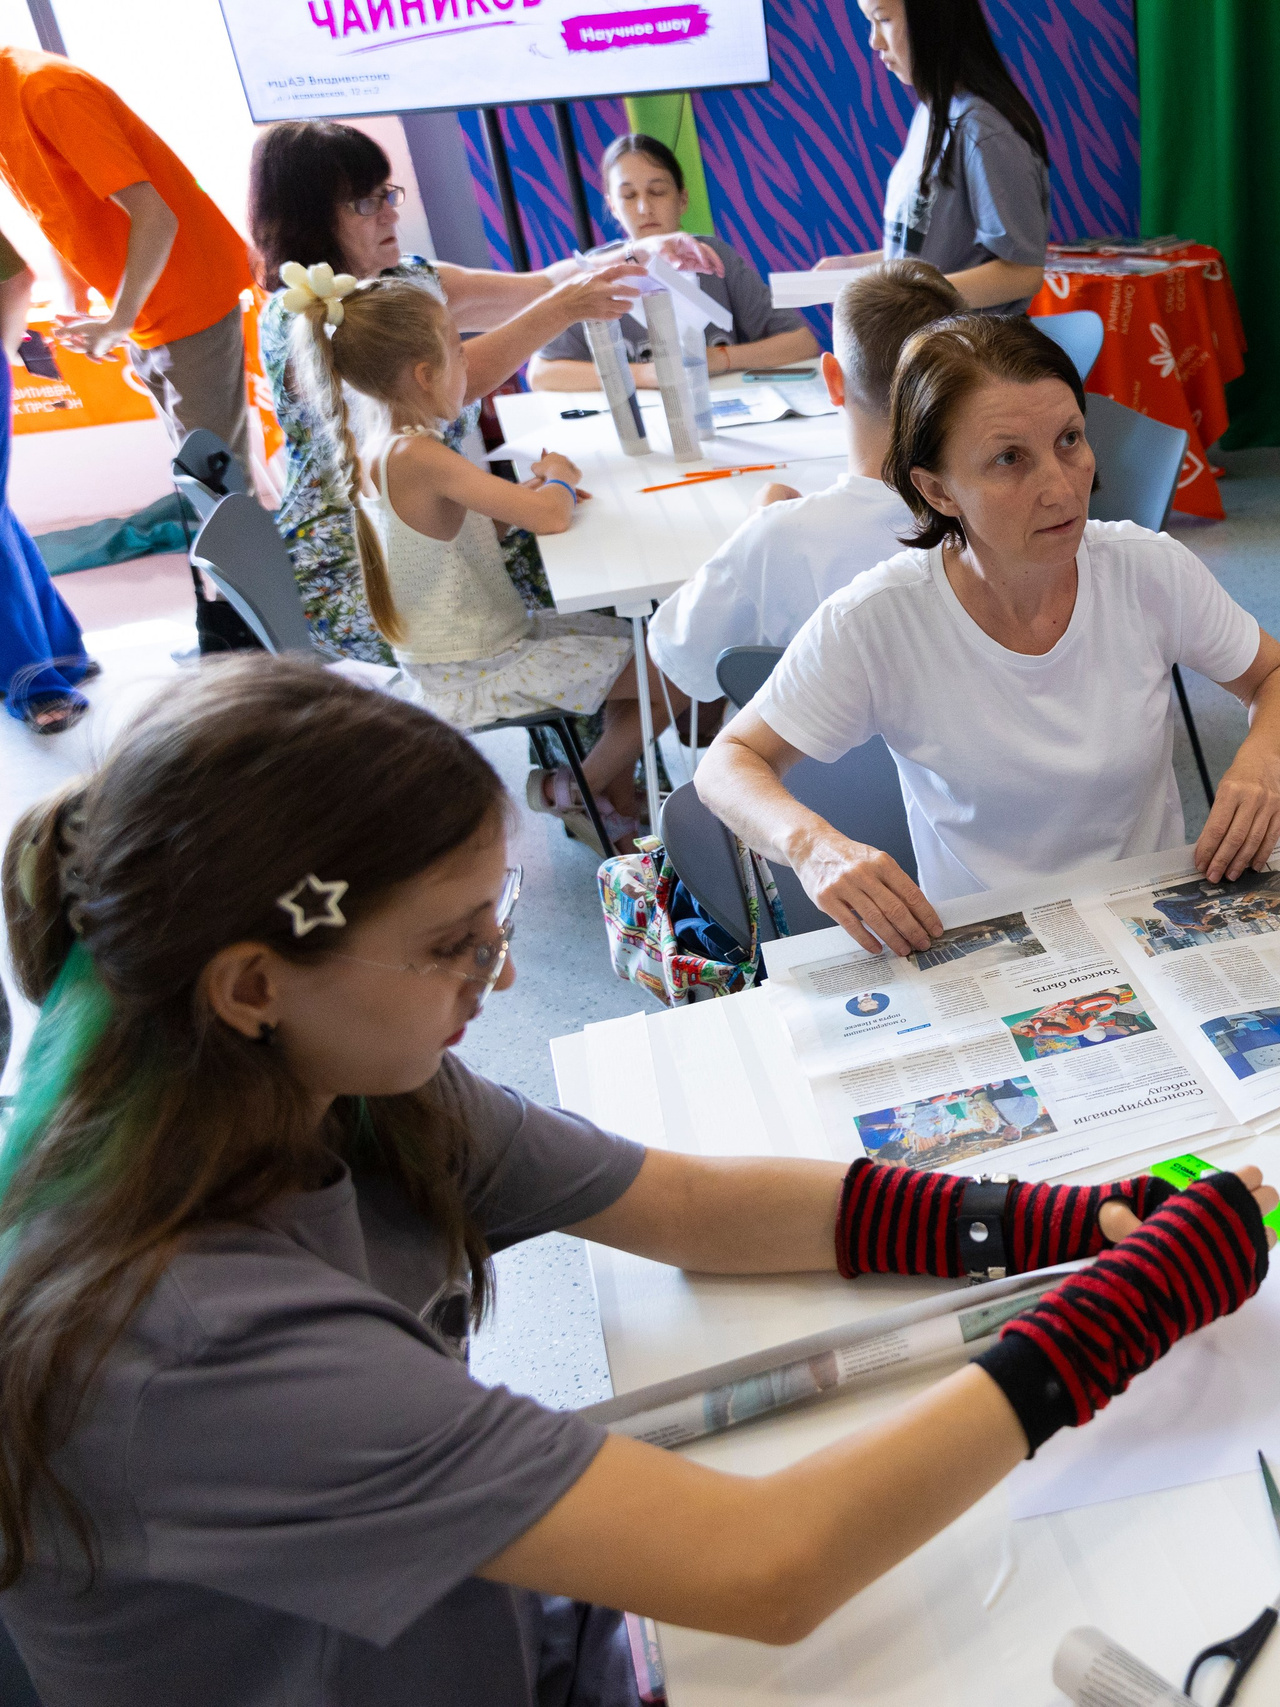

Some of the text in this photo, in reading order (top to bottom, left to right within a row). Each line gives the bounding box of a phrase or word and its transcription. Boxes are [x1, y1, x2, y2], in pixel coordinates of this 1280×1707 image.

[308, 0, 543, 39] ЧАЙНИ
[579, 16, 692, 43] Научное шоу
[24, 398, 83, 413] ПРООН
[1031, 974, 1062, 994] быть
[1063, 966, 1121, 988] Хоккею
[843, 1020, 899, 1038] модернизации
[1148, 1079, 1198, 1096] победу
[1073, 1088, 1204, 1125] Сконструировали
